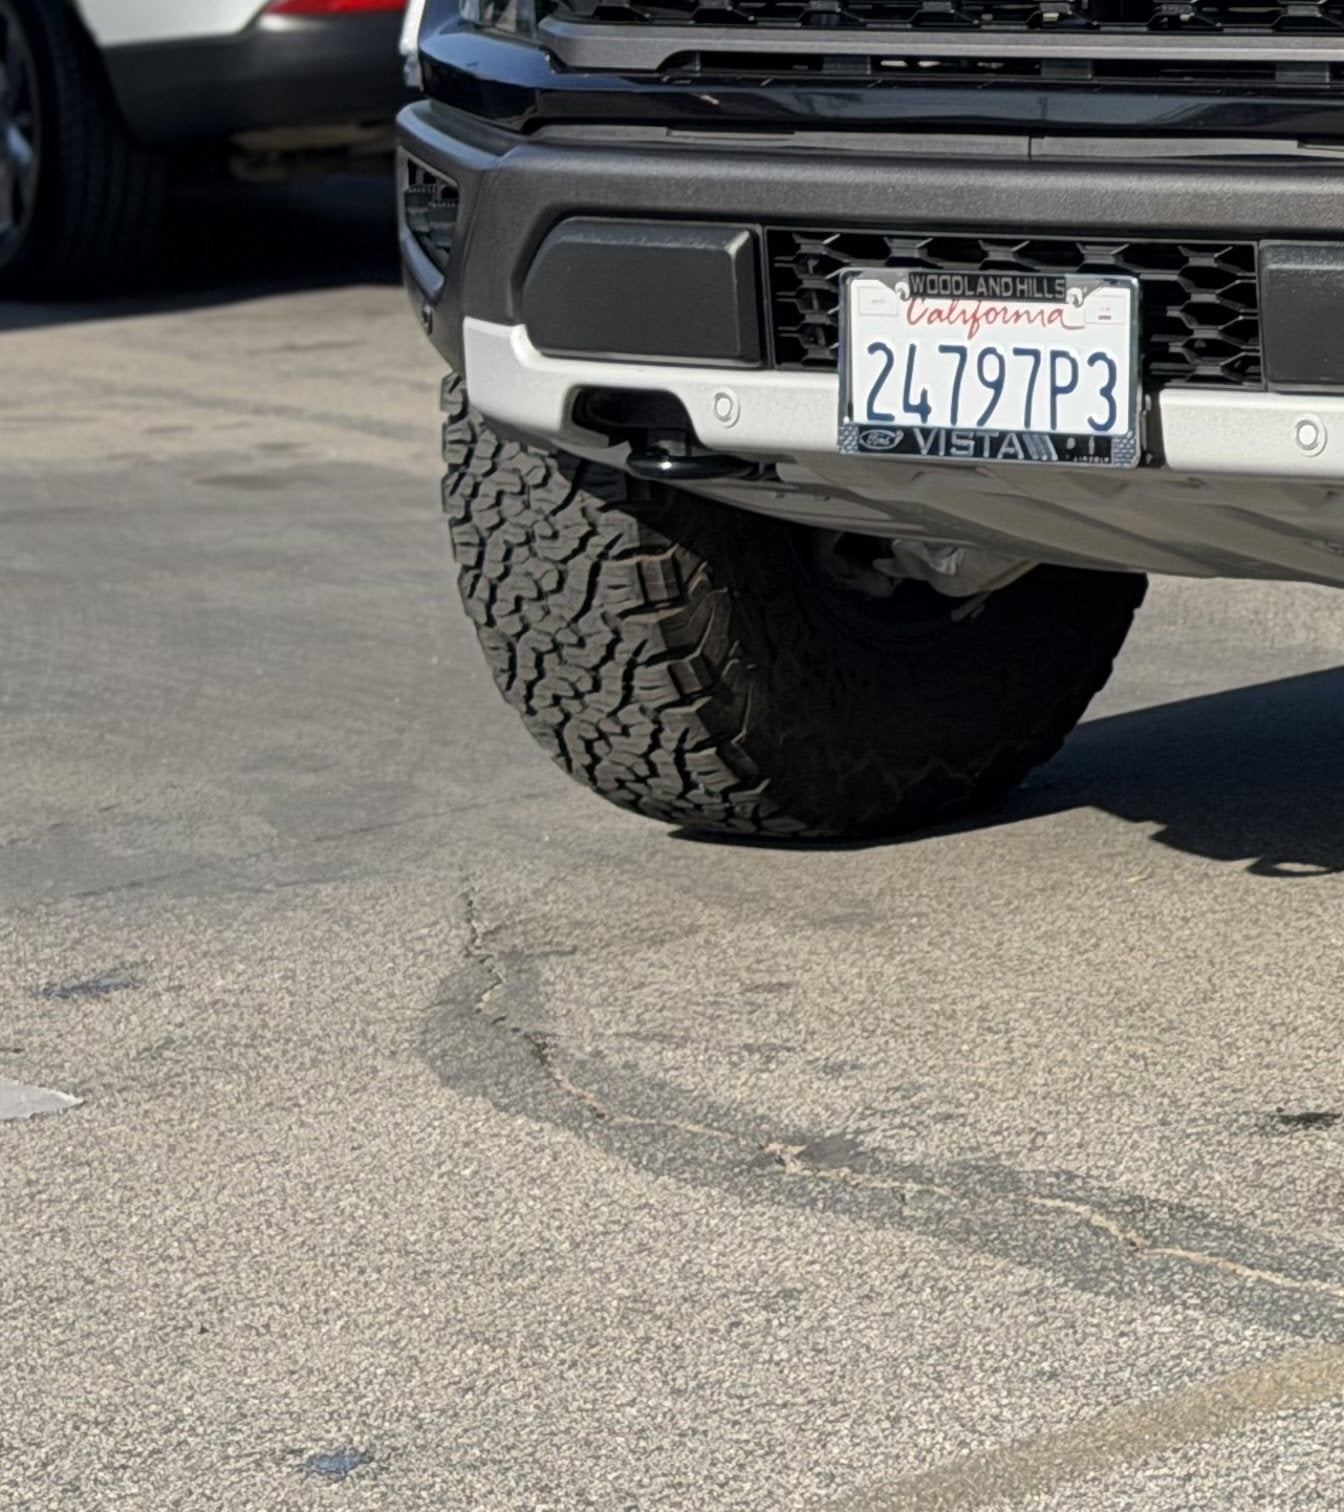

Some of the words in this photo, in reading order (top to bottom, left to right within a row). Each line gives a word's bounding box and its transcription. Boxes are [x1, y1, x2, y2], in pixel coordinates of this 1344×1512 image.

[909, 276, 1014, 298] WOODLAND
[1016, 279, 1065, 299] HILLS
[906, 296, 1085, 340] California
[866, 342, 1117, 431] 24797P3
[913, 428, 1024, 460] VISTA
